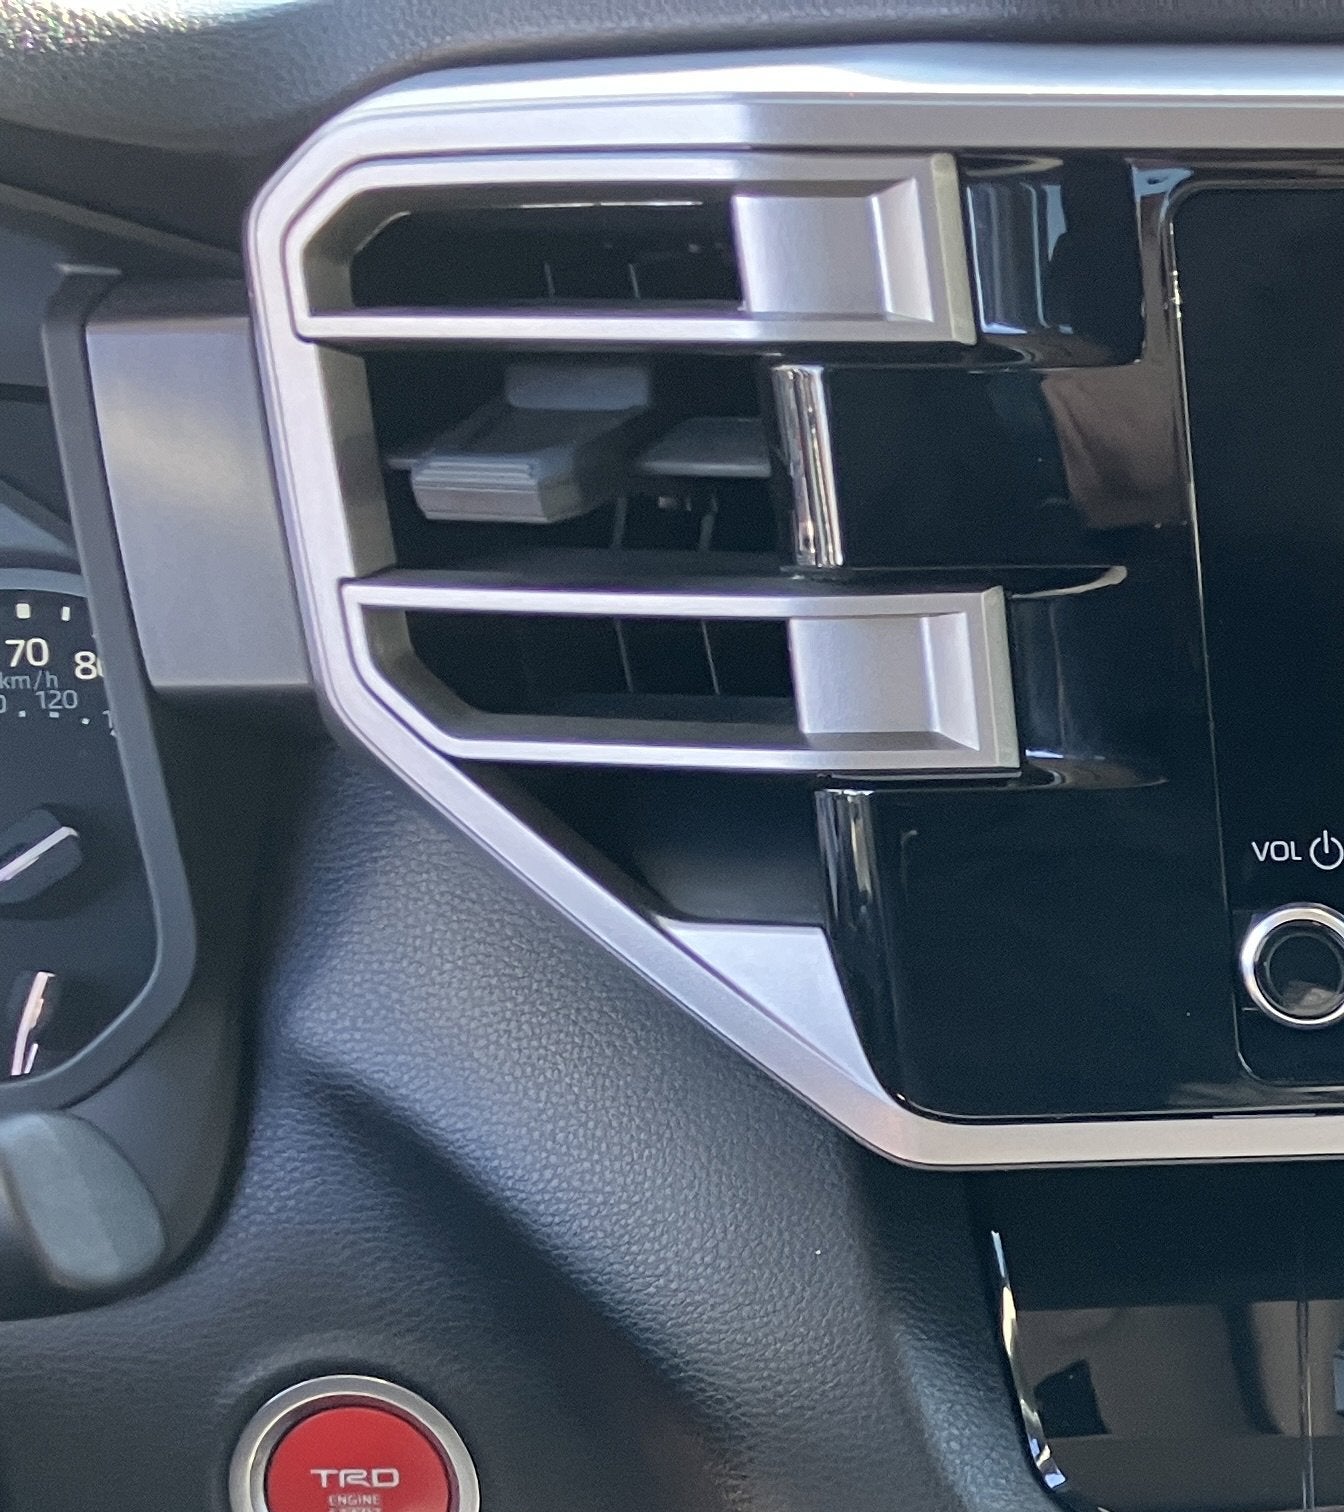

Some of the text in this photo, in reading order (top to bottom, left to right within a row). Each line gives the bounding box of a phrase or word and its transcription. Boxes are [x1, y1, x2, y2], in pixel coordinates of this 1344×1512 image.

[4, 637, 50, 668] 70
[74, 650, 104, 680] 8
[35, 689, 78, 710] 120
[1252, 840, 1302, 862] VOL
[310, 1468, 400, 1488] TRD
[328, 1494, 382, 1506] ENGINE
